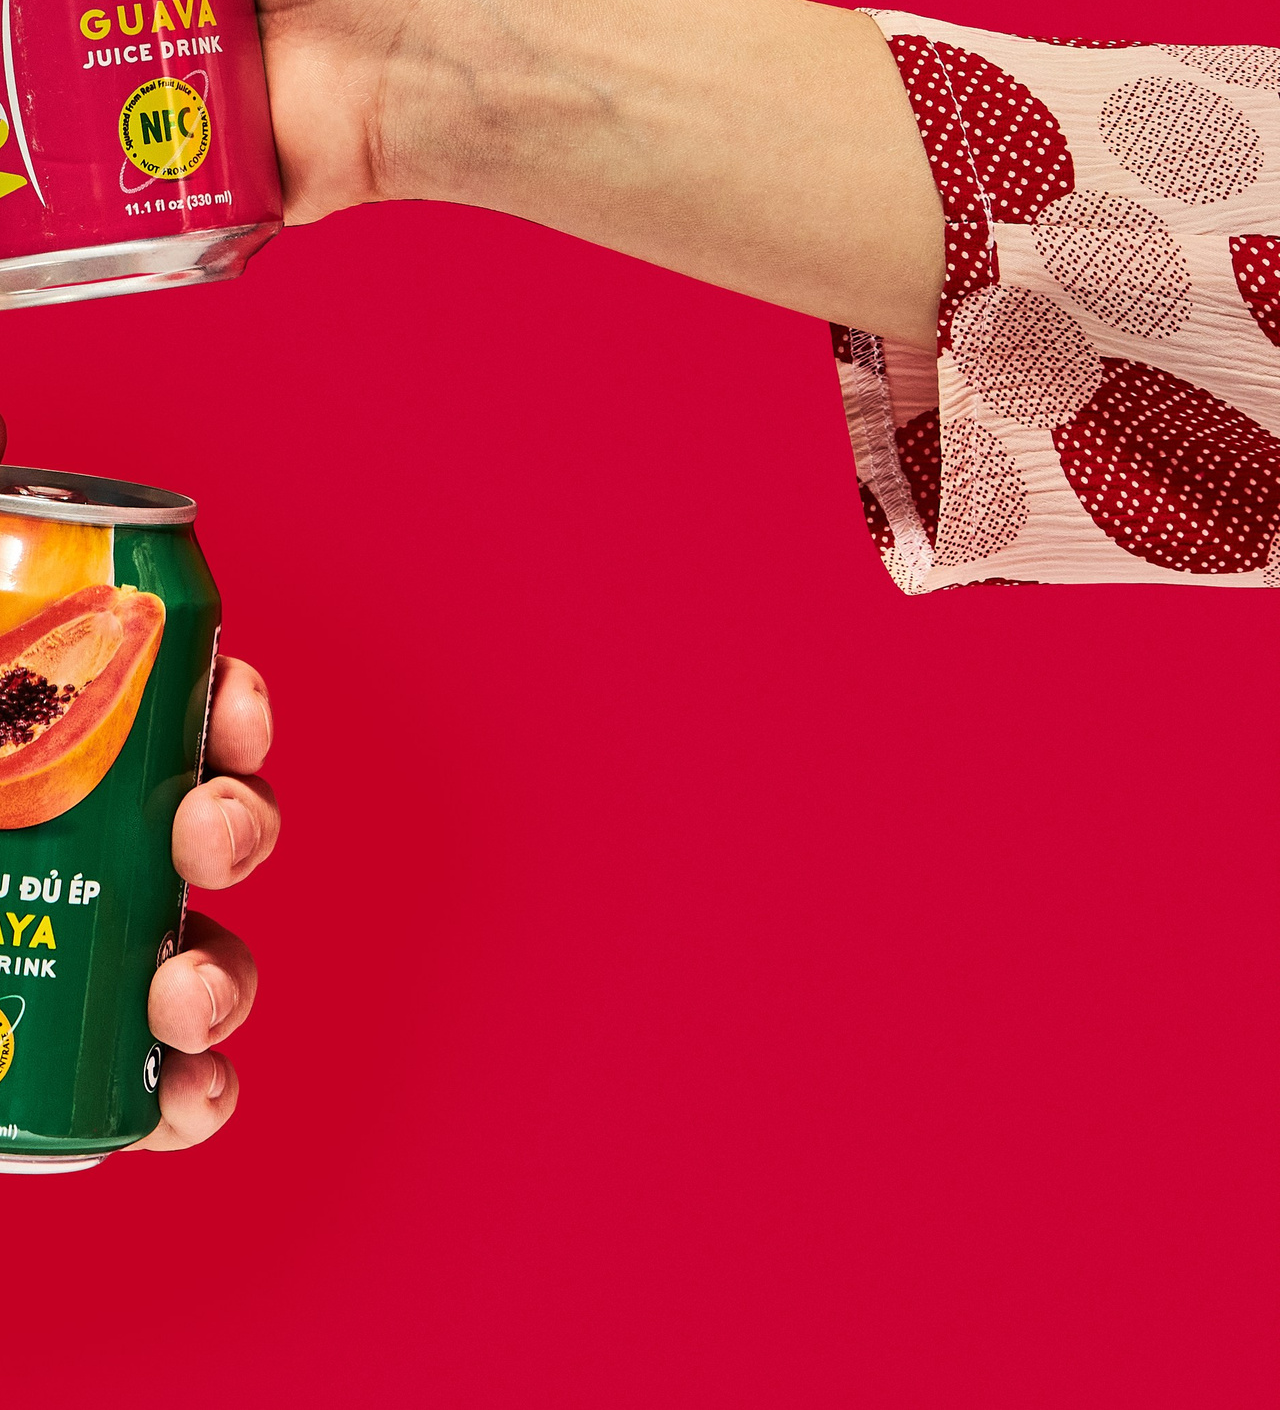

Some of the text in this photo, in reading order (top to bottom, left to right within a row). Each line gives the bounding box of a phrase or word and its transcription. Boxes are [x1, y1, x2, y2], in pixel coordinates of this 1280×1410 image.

[83, 35, 223, 69] JUICE DRINK
[141, 82, 157, 96] Real
[175, 81, 192, 95] Juice
[125, 93, 142, 112] From
[123, 112, 134, 151] Squeezed
[140, 107, 194, 145] NFC
[140, 159, 160, 174] NOT
[125, 190, 232, 216] 11.1 fl oz (330 ml)
[19, 869, 62, 904] ĐỦ
[68, 872, 101, 905] ÉP
